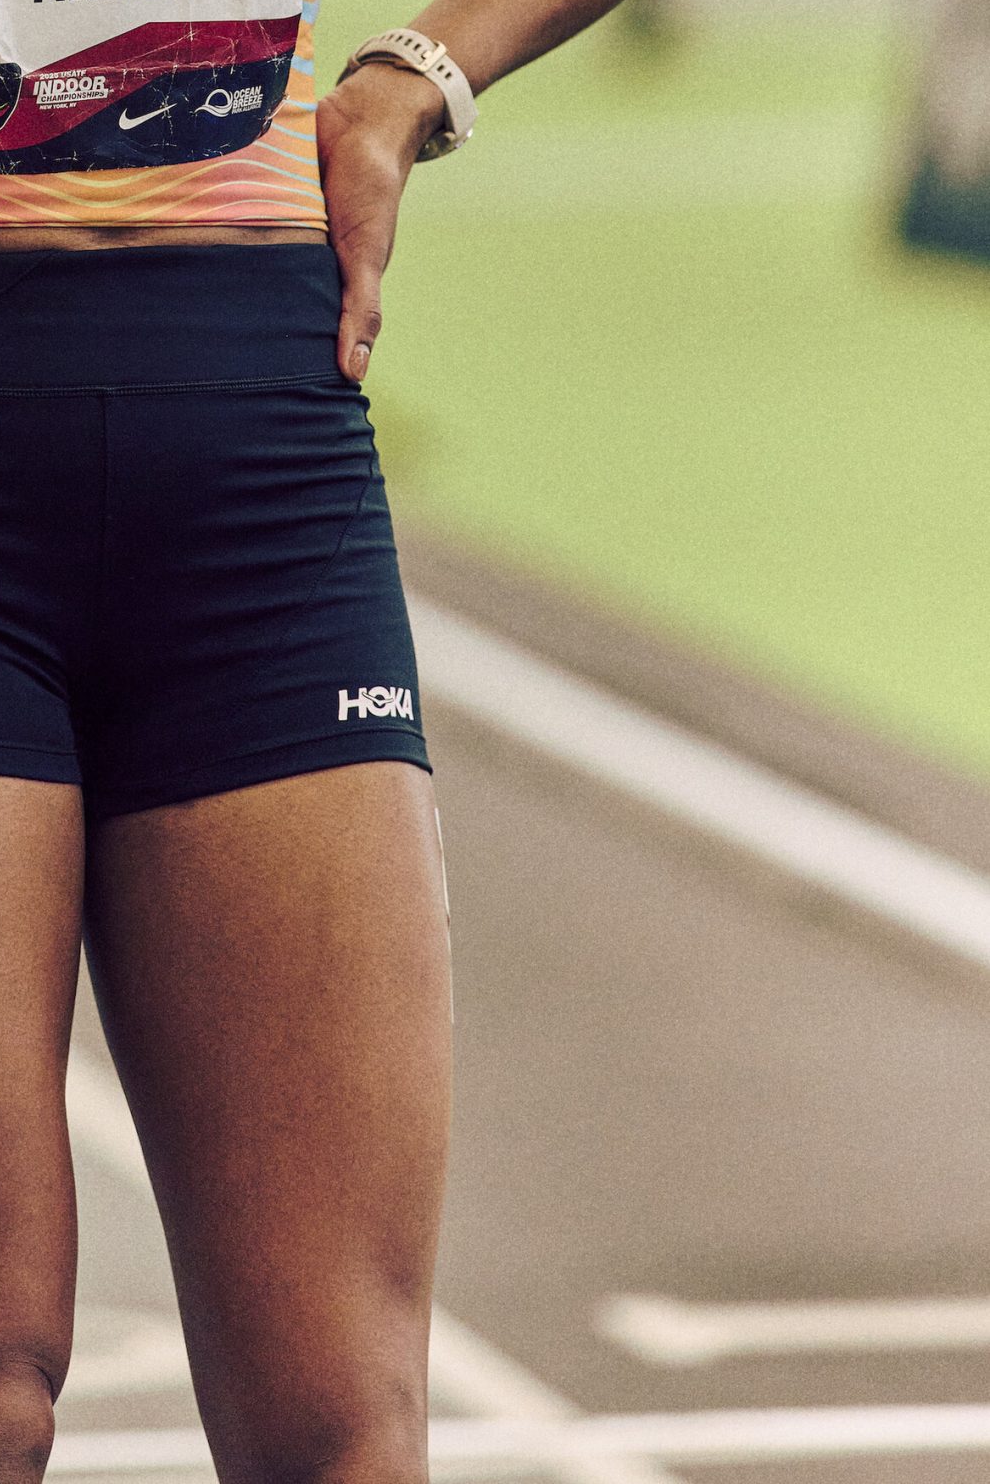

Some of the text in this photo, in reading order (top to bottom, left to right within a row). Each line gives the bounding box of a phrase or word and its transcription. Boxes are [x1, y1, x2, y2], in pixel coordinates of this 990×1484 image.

[39, 70, 87, 80] 2025 USATF
[33, 76, 106, 96] INDOOR
[234, 85, 262, 100] OCEAN
[40, 91, 105, 103] CHAMPIONSHIPS
[232, 94, 264, 109] BREEZE
[338, 686, 414, 721] HOKA
